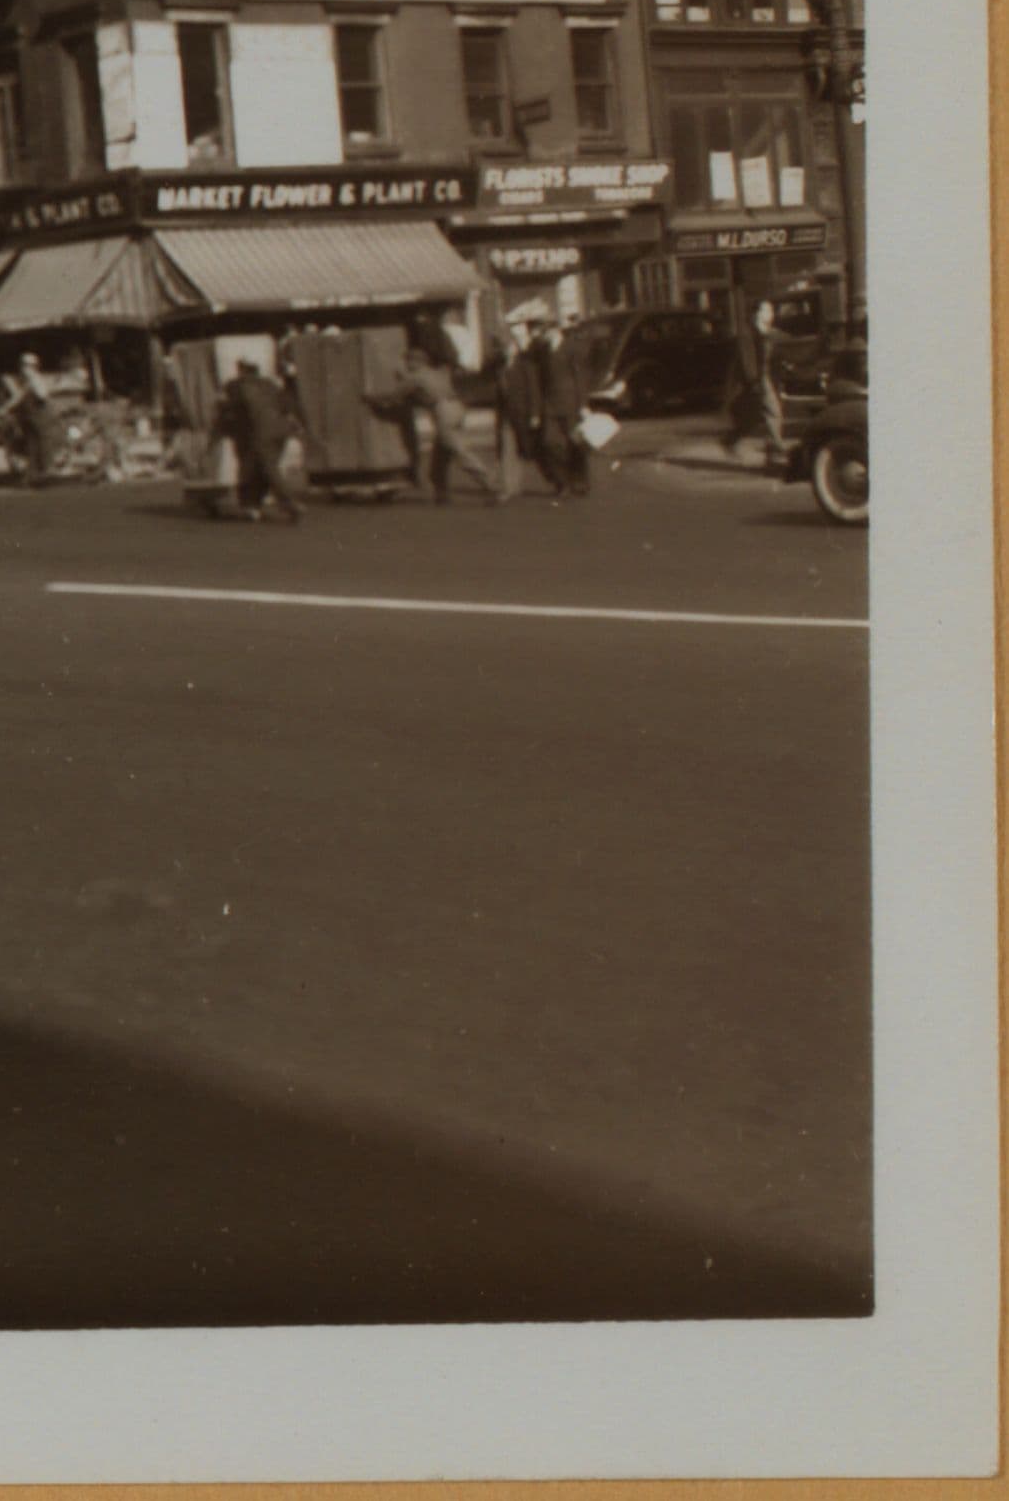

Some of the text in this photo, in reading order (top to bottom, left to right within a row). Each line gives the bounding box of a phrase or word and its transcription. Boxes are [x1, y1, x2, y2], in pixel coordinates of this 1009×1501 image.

[484, 163, 670, 190] FLORISTS SMOKE SHOP
[157, 184, 245, 211] MARKET
[249, 182, 332, 209] FLOWER
[338, 182, 356, 206] &
[361, 180, 426, 205] PLANT
